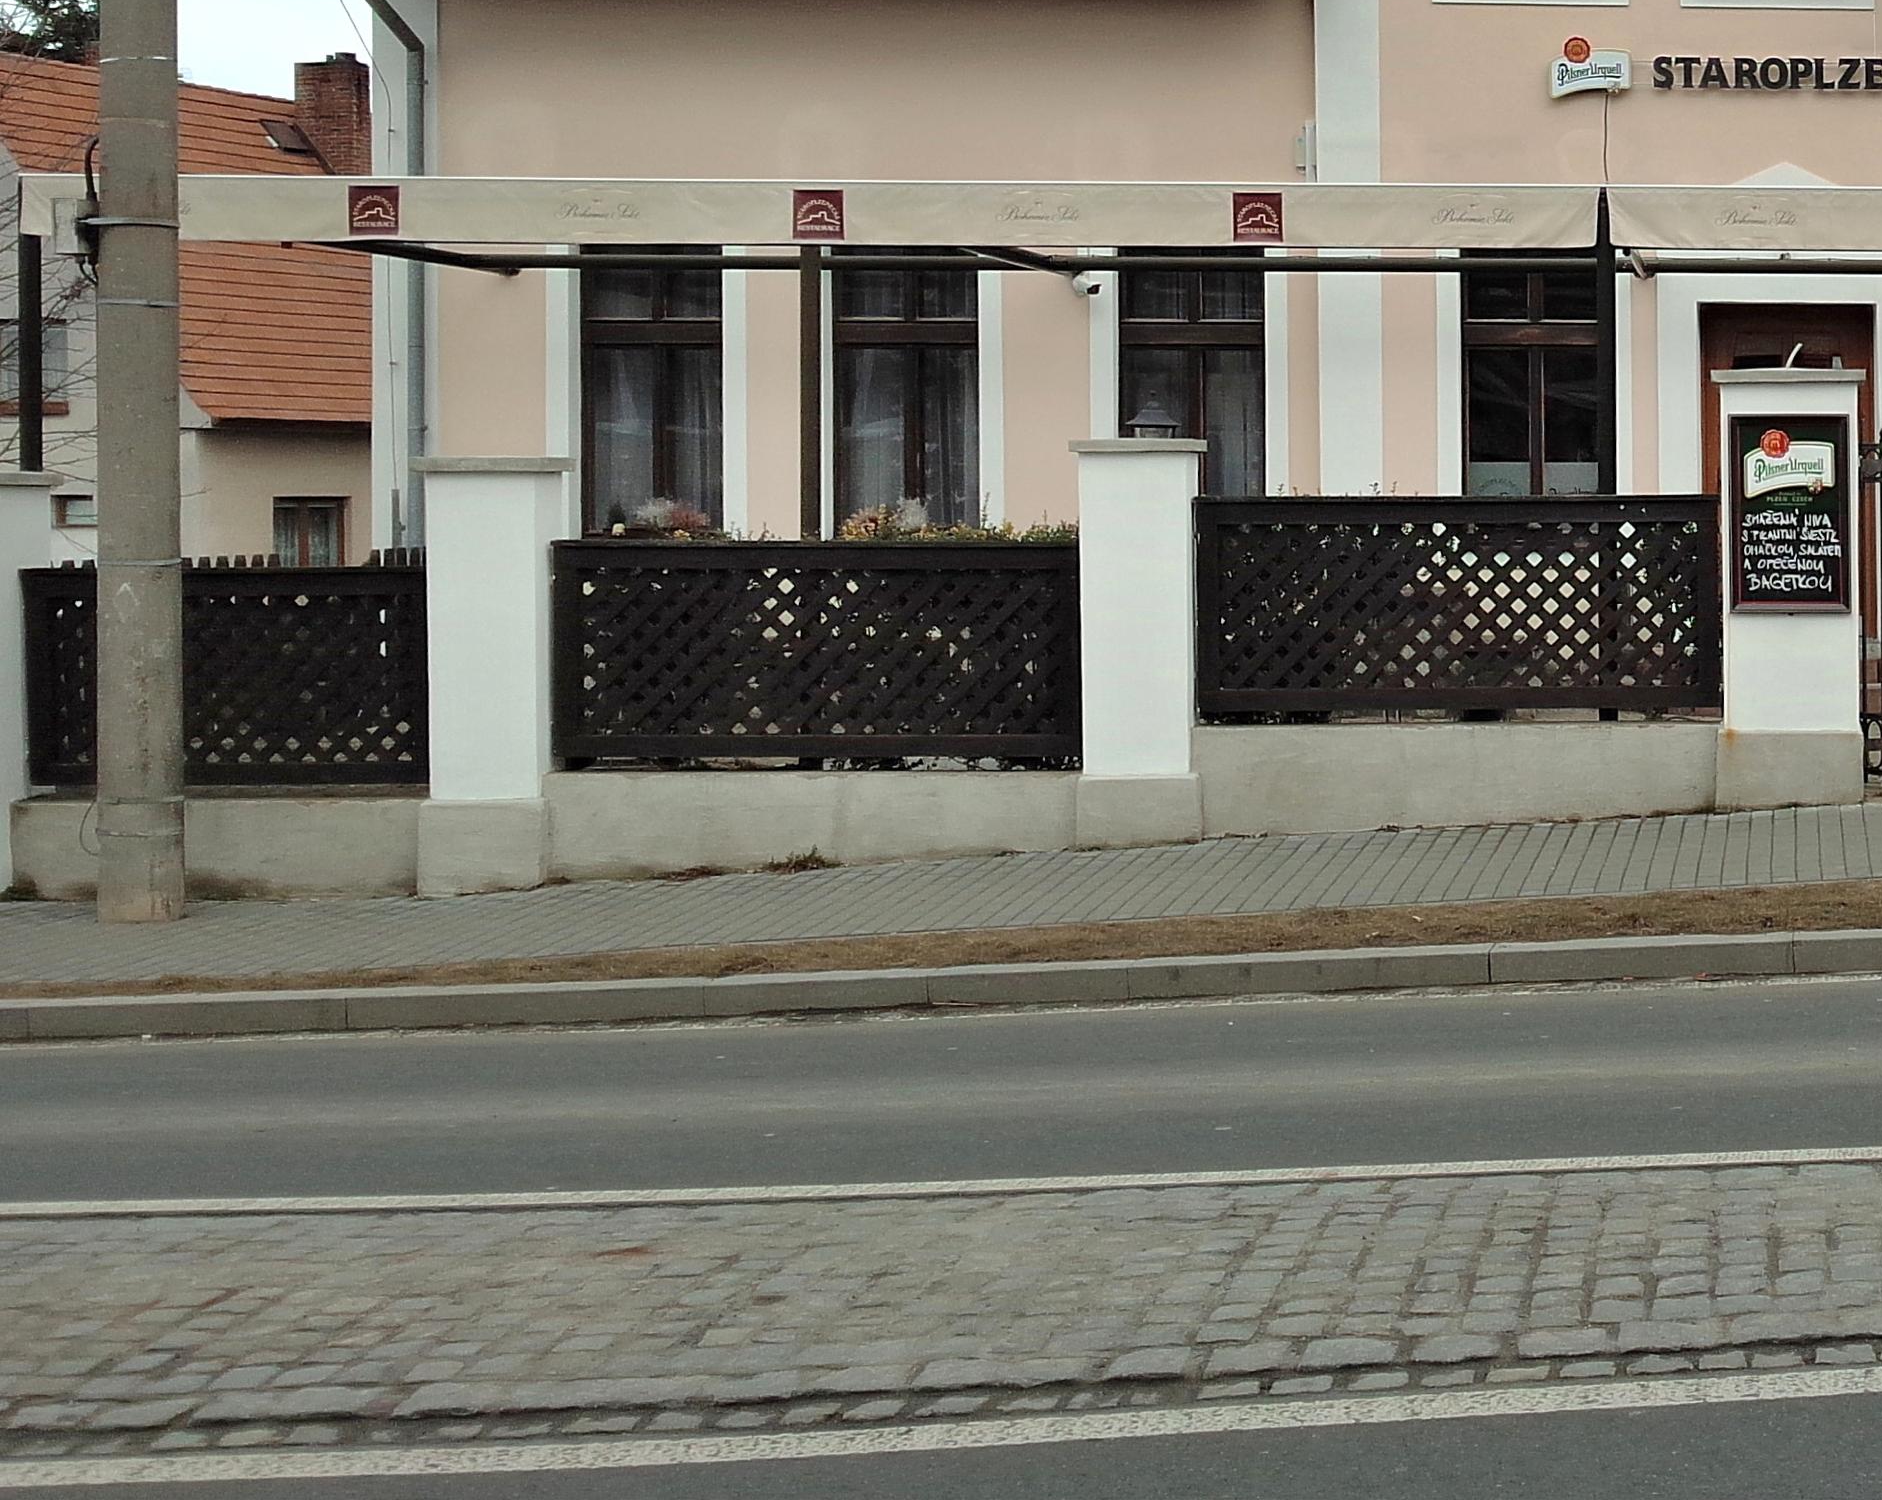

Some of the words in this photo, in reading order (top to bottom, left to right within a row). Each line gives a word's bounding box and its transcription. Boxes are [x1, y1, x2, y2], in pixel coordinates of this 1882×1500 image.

[1557, 62, 1590, 87] Pilsner
[1589, 62, 1622, 80] Urquell
[1754, 457, 1789, 484] Pilsner
[1788, 457, 1824, 477] Urquell
[1742, 508, 1799, 527] SMAŽENÁ
[1804, 513, 1832, 529] NIVA
[1741, 529, 1749, 542] S
[1798, 541, 1842, 558] SALÁTEM
[1744, 558, 1752, 570] A
[1746, 573, 1832, 592] BAGETKOU
